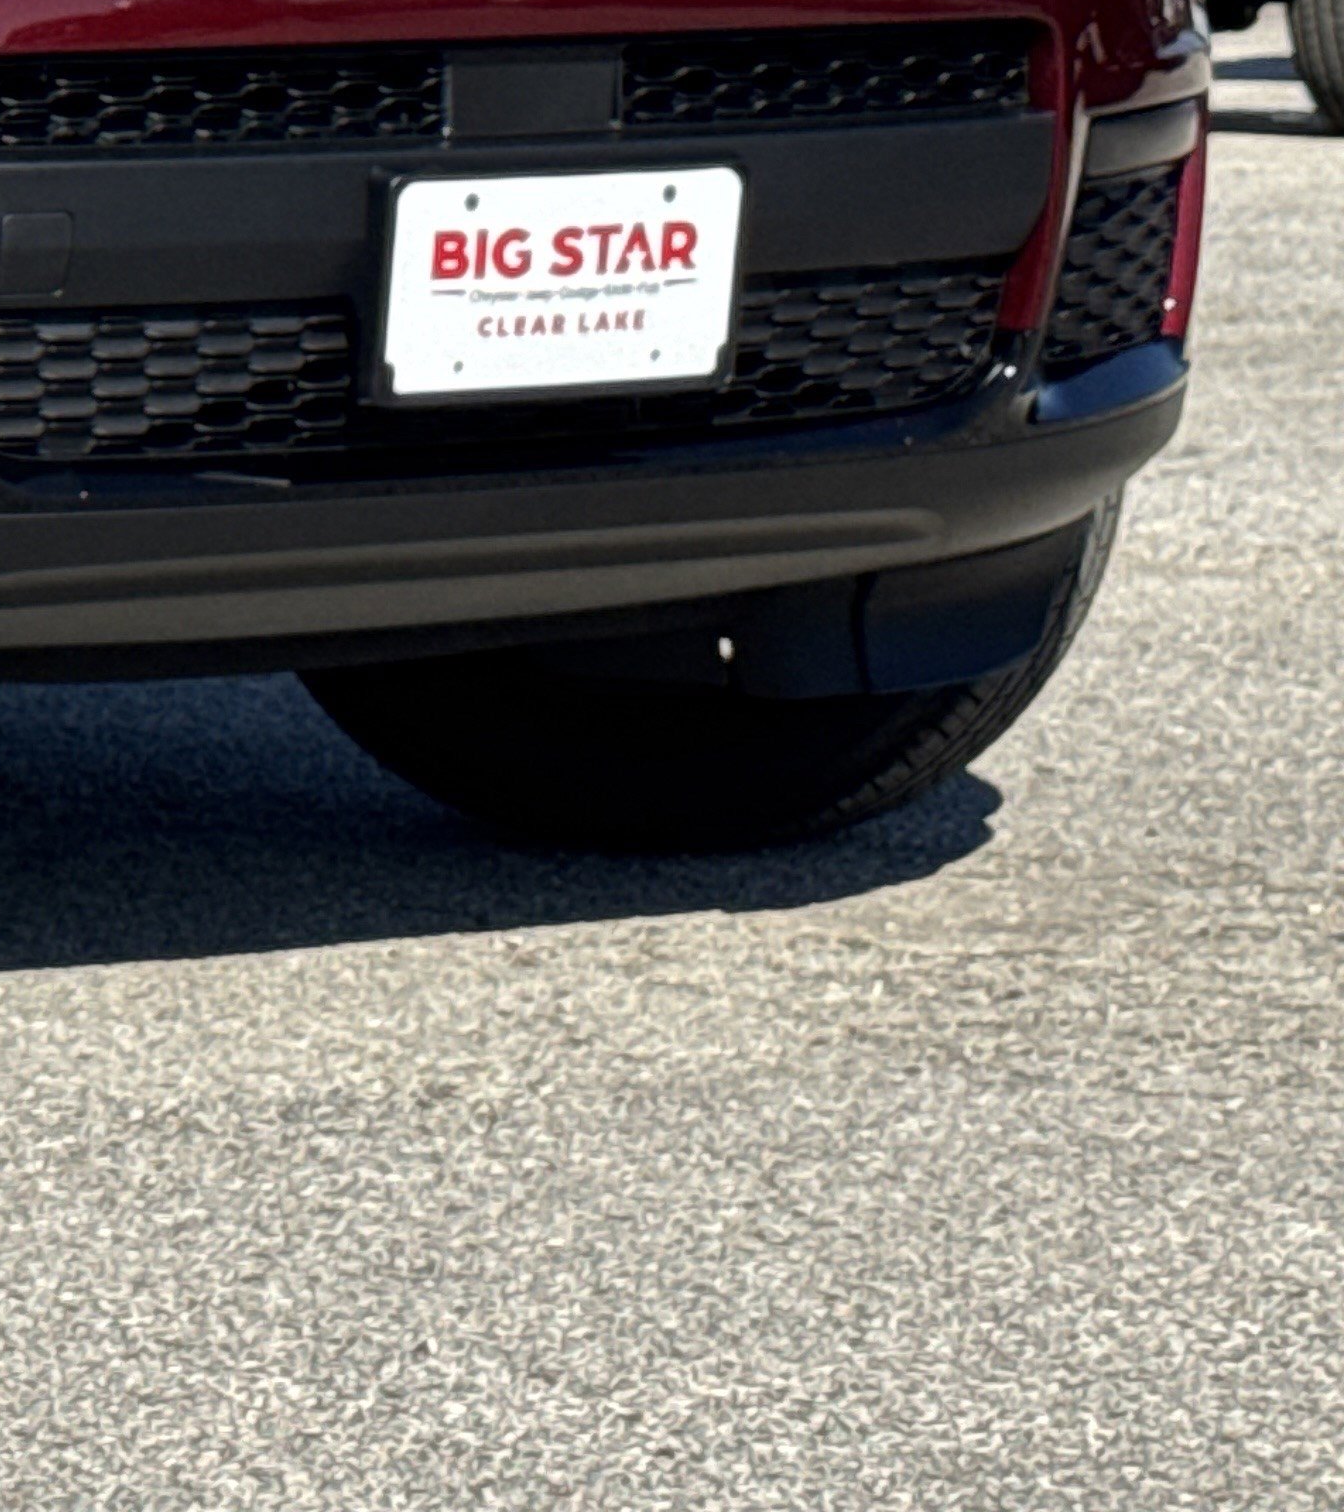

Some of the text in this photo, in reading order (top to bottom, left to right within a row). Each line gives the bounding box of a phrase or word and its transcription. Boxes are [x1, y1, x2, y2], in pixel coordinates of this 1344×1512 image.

[430, 220, 698, 281] BIG STAR
[476, 308, 646, 338] CLEAR LAKE
